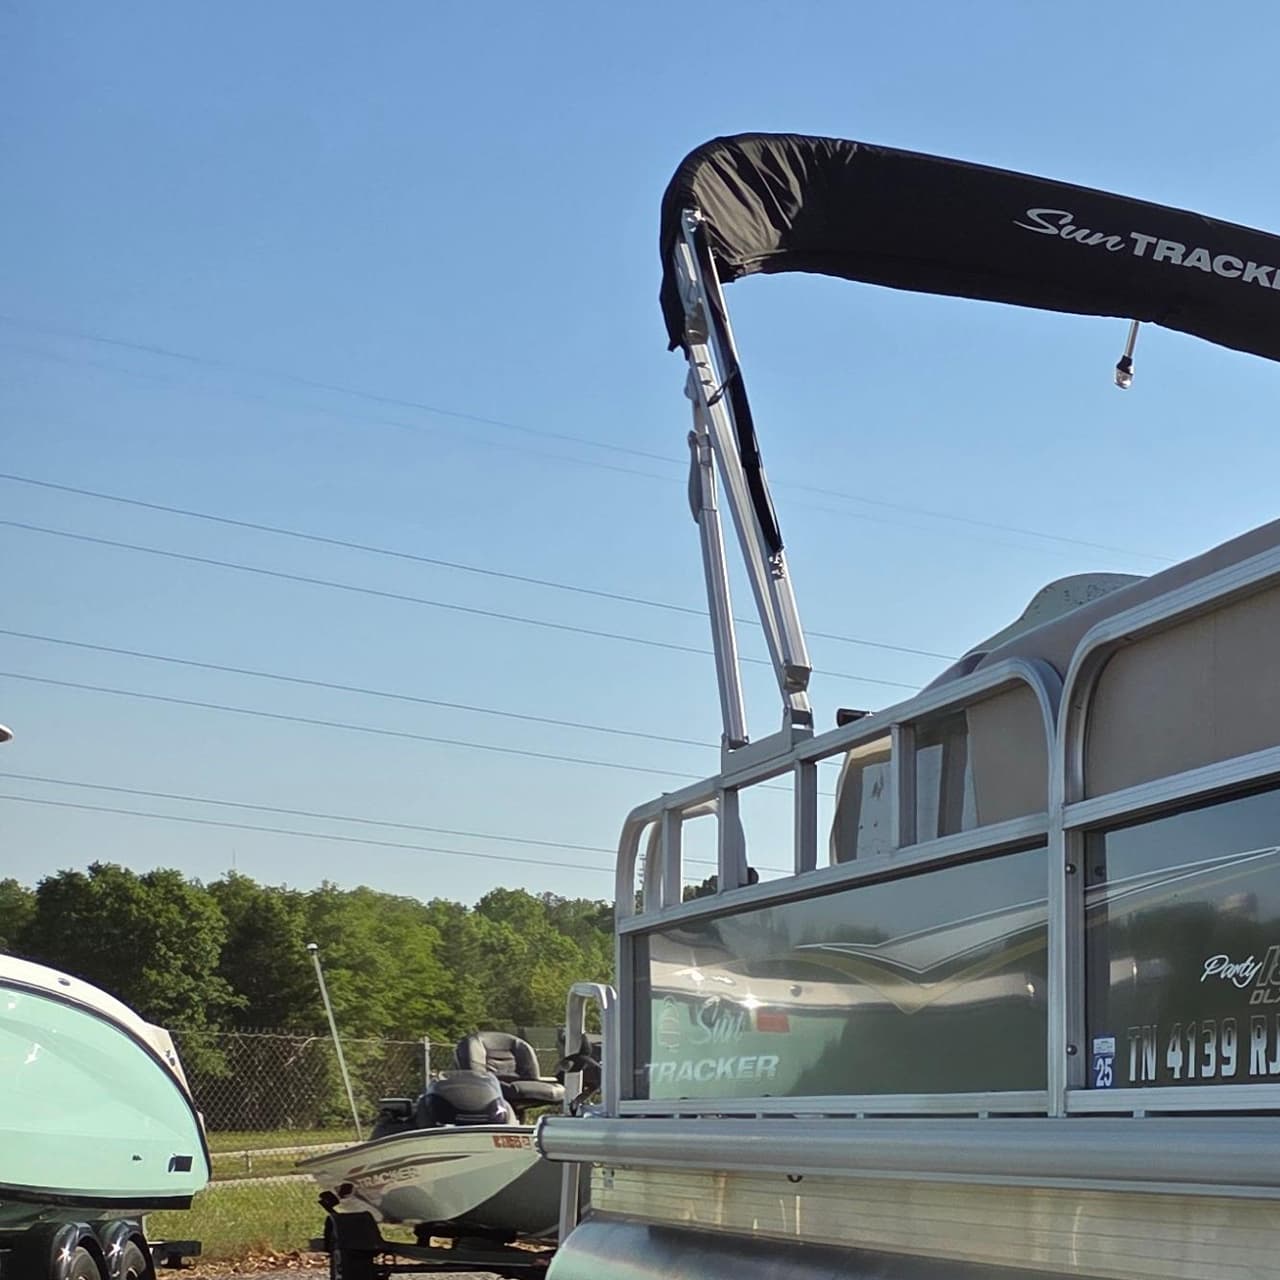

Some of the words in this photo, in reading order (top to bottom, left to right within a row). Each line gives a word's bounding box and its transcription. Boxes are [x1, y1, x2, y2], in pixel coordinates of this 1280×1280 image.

[1012, 207, 1126, 251] Sun
[1200, 954, 1263, 988] Party
[644, 1055, 780, 1083] TRACKER
[1127, 1025, 1158, 1082] TN
[1093, 1056, 1113, 1087] 25
